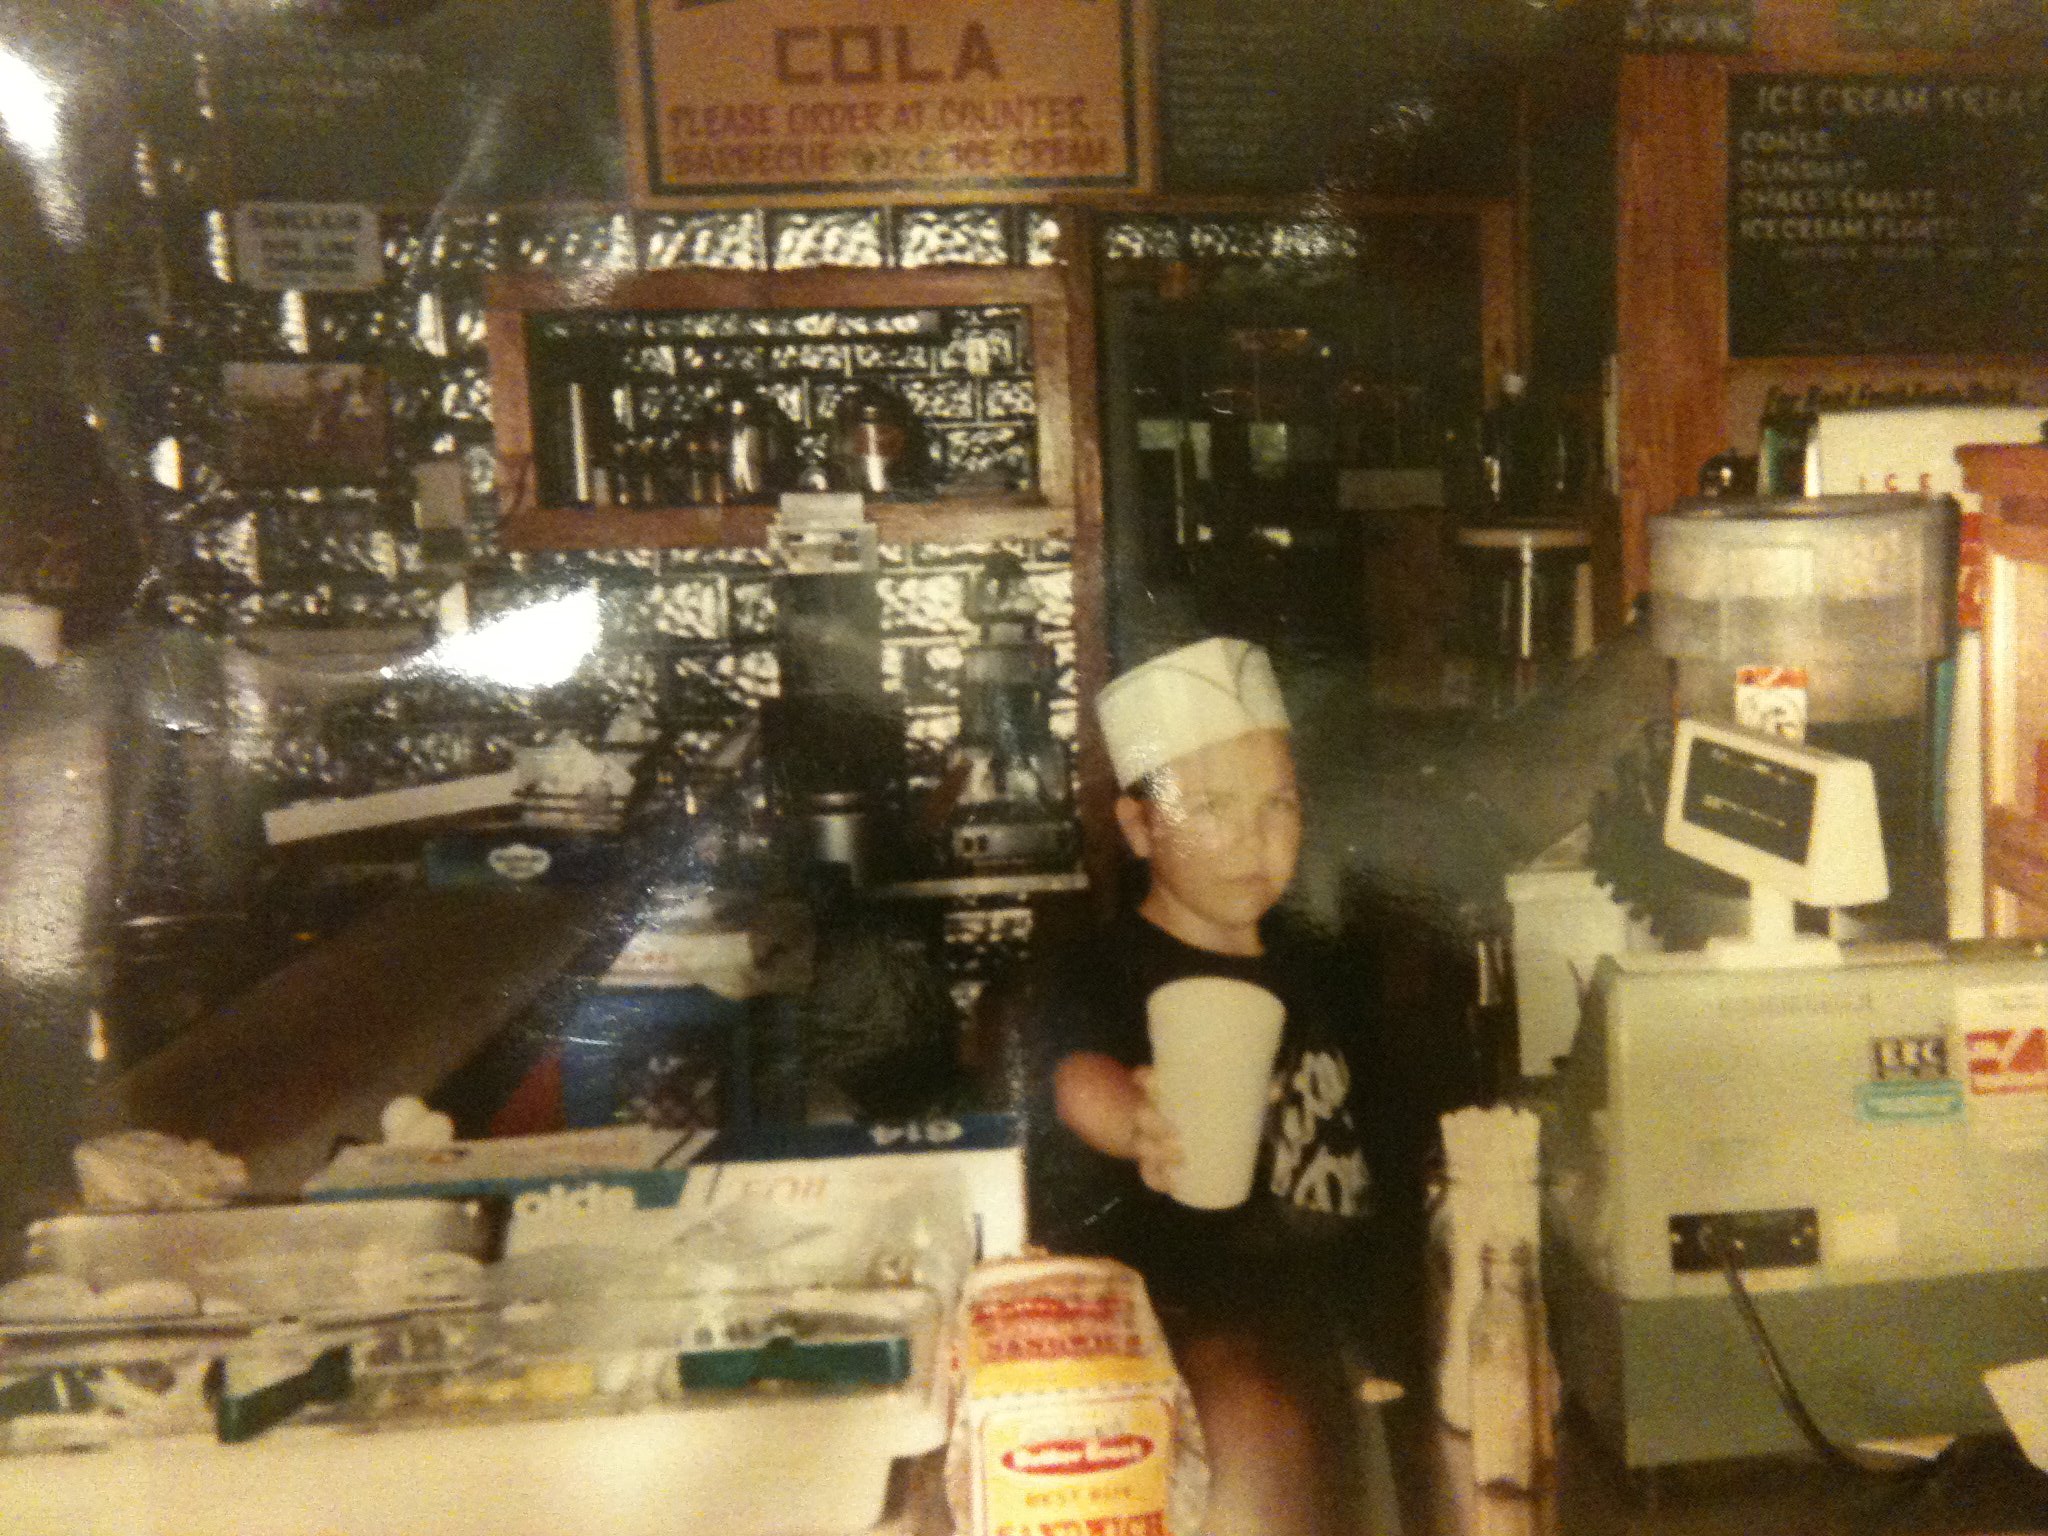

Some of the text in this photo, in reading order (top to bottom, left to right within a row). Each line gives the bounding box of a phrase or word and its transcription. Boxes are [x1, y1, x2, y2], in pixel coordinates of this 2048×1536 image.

[775, 22, 1001, 84] COLA
[668, 97, 1090, 137] PLEASE ORDER AT COUNTER
[1758, 86, 1807, 114] ICE
[1819, 86, 1930, 116] CREAM
